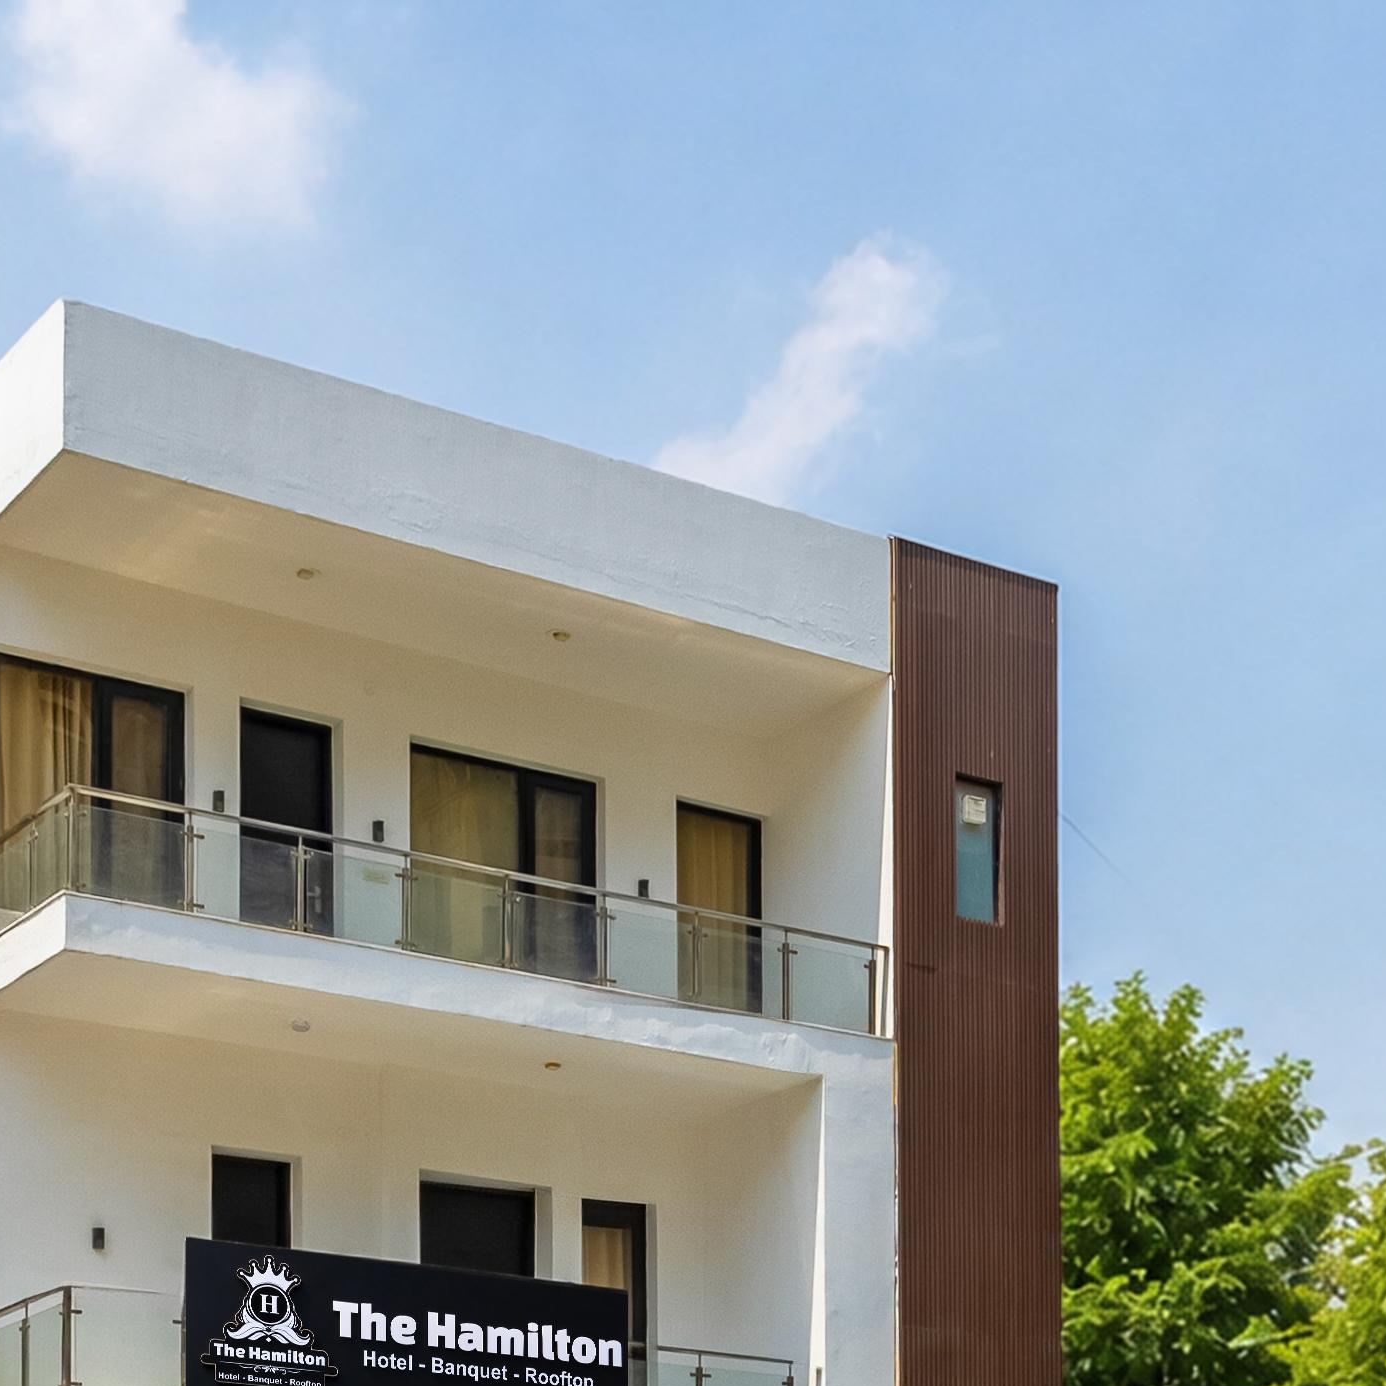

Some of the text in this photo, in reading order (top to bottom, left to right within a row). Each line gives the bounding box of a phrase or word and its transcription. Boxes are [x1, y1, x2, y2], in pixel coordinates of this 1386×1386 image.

[259, 1293, 280, 1315] H
[332, 1300, 623, 1368] The Hamilton
[213, 1342, 326, 1366] The Hamilton
[363, 1349, 413, 1371] Hotel
[431, 1356, 508, 1382] Banquet
[218, 1371, 240, 1381] Hotel
[247, 1374, 283, 1385] Banquet
